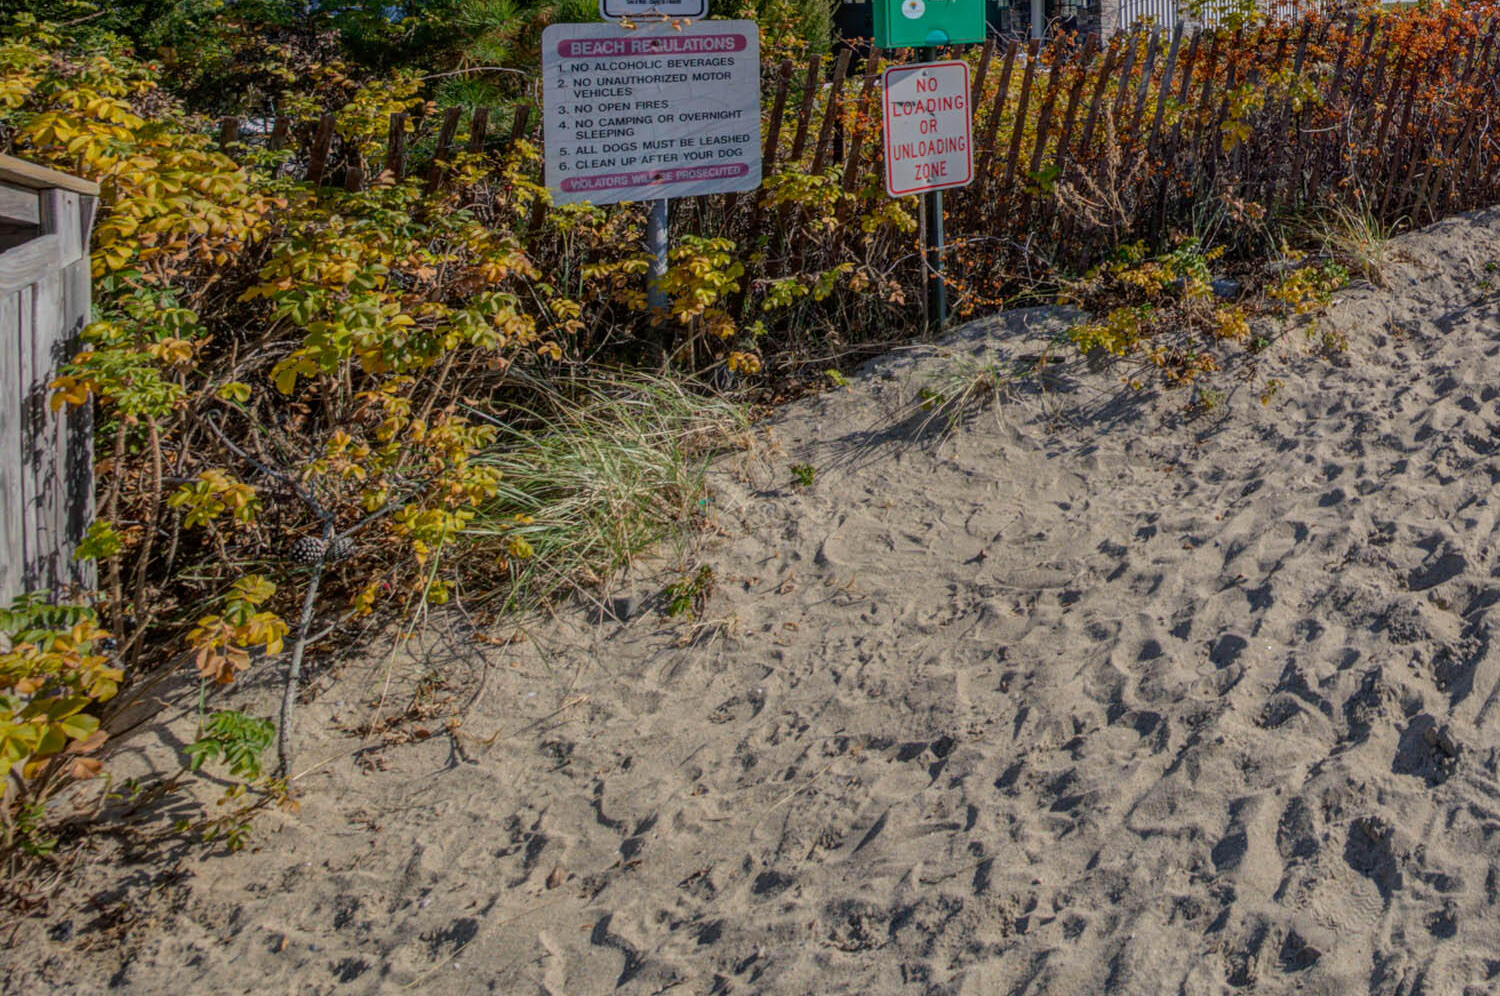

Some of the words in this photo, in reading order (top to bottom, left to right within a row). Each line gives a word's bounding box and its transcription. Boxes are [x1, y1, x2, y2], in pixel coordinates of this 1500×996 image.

[570, 39, 625, 55] BEACH
[631, 37, 736, 53] REGULATIONS
[558, 64, 566, 73] 1.
[571, 63, 589, 73] NO
[594, 60, 663, 72] ALCOHOLIC
[667, 57, 735, 69] BEVERAGES
[557, 79, 568, 88] 2.
[573, 78, 592, 87] NO
[596, 73, 688, 86] UNAUTHORIZED
[692, 71, 732, 81] MOTOR
[916, 77, 938, 93] NO
[573, 87, 633, 99] VEHICLES
[558, 106, 569, 115] 3.
[574, 104, 593, 114] NO
[598, 102, 631, 112] OPEN
[635, 100, 669, 110] FIRES
[892, 95, 964, 117] LOADING
[558, 121, 570, 130] 4.
[575, 119, 593, 129] NO
[598, 115, 653, 127] CAMPING
[657, 114, 674, 123] OR
[679, 109, 743, 122] OVERNIGHT
[920, 119, 937, 135] OR
[575, 128, 635, 140] SLEEPING
[559, 147, 570, 157] 5.
[575, 145, 598, 155] ALL
[602, 142, 638, 153] DOGS
[642, 139, 674, 150] MUST
[679, 138, 694, 147] BE
[699, 133, 751, 146] LEASHED
[893, 136, 966, 161] UNLOADING
[559, 162, 570, 171] 6.
[575, 159, 616, 170] CLEAN
[621, 156, 637, 166] UP
[641, 153, 679, 165] AFTER
[683, 151, 714, 161] YOUR
[718, 148, 743, 158] DOG
[570, 176, 628, 189] VIOLATORS
[676, 166, 741, 180] PROSECUTED
[915, 160, 947, 181] ZONE
